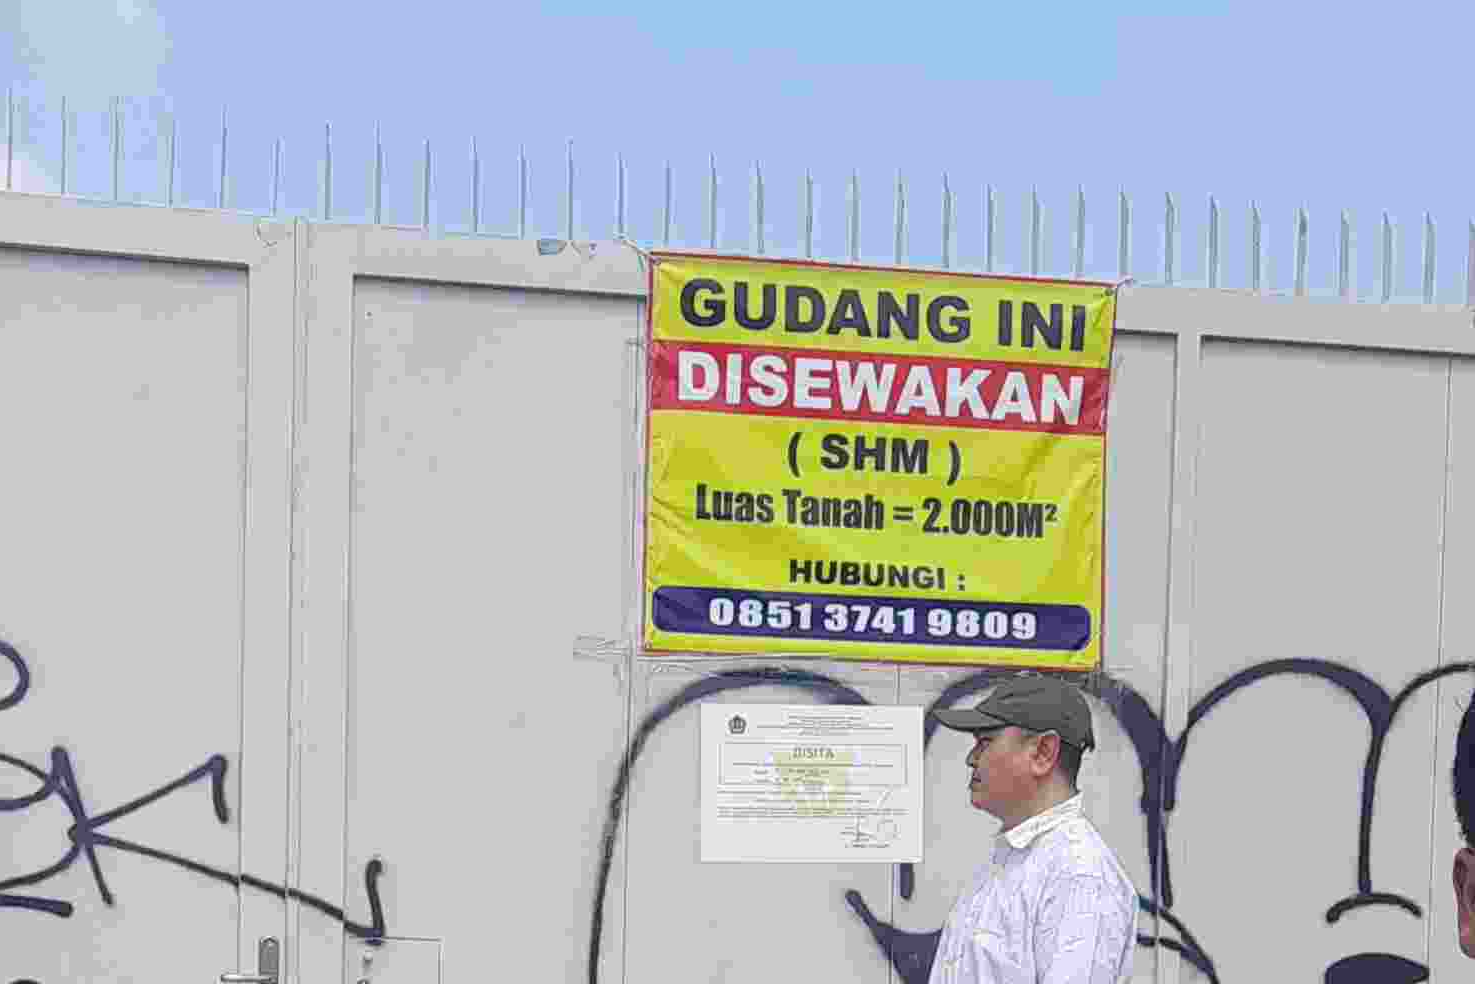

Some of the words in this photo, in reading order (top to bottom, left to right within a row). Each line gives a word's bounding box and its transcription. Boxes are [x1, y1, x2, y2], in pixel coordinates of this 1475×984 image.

[679, 278, 971, 344] GUDANG
[997, 299, 1087, 352] INI
[677, 349, 1085, 426] DISEWAKAN
[695, 483, 774, 524] Luas
[782, 488, 885, 531] Tanah
[789, 559, 946, 590] HUBUNGI
[708, 597, 812, 631] 0851
[824, 603, 916, 635] 3741
[928, 608, 1037, 640] 9809
